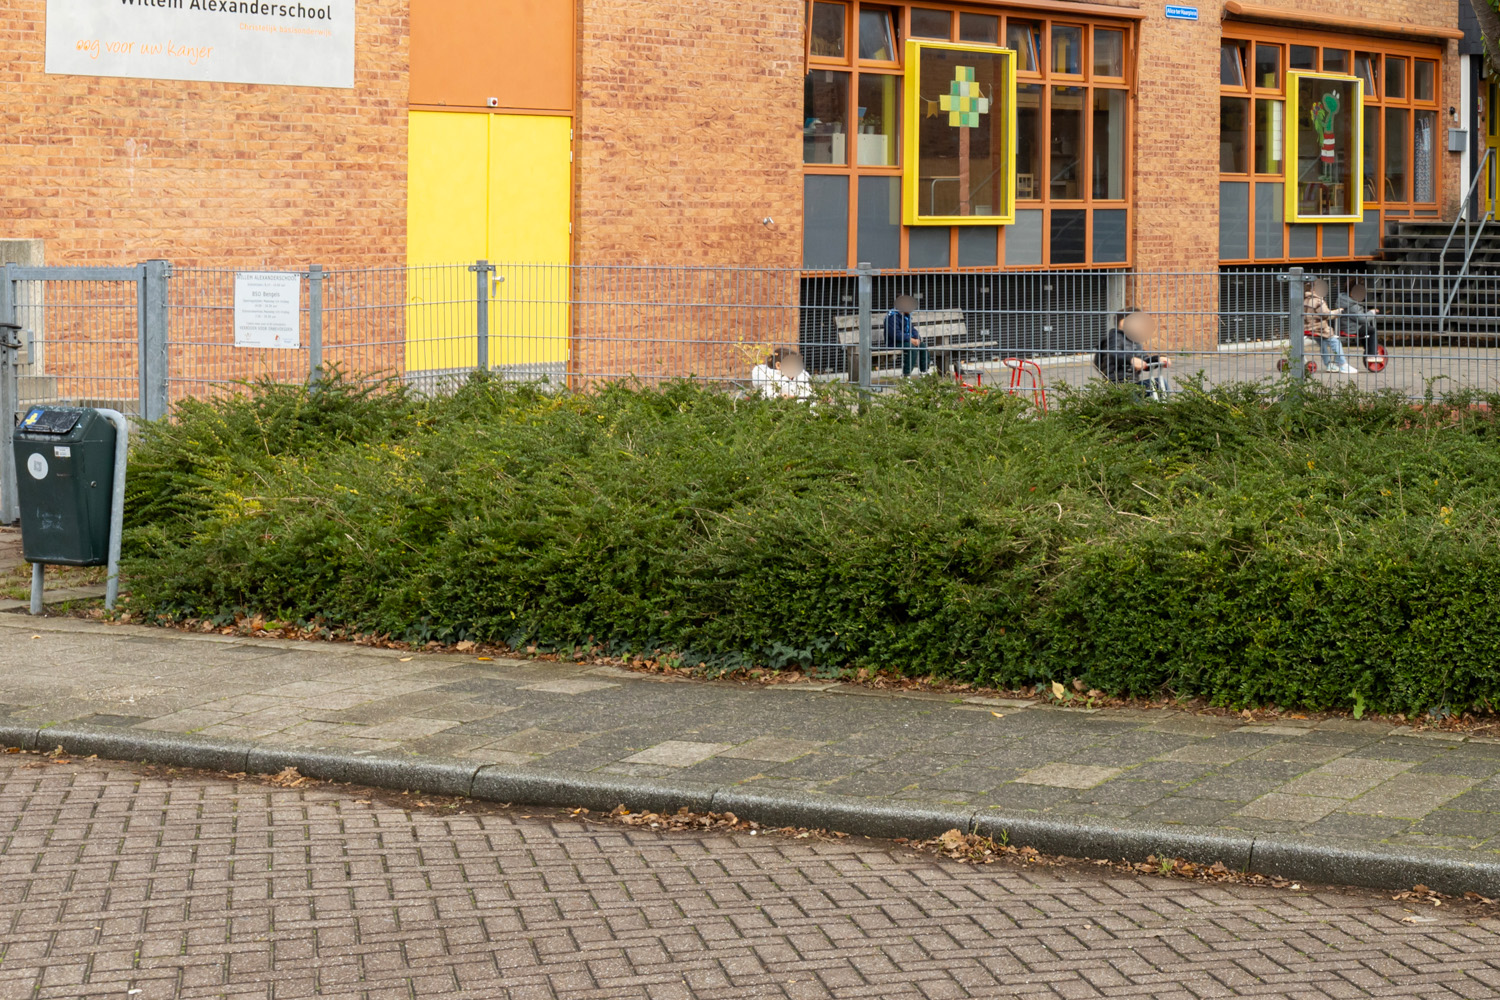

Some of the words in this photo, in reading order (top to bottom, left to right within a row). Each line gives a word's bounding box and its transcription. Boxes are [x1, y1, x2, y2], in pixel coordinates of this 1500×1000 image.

[239, 23, 277, 34] Christelijk
[279, 26, 332, 38] basisonderwijs
[76, 40, 99, 60] oog
[105, 40, 136, 54] voor
[140, 42, 162, 54] uw
[167, 40, 213, 65] kanjer
